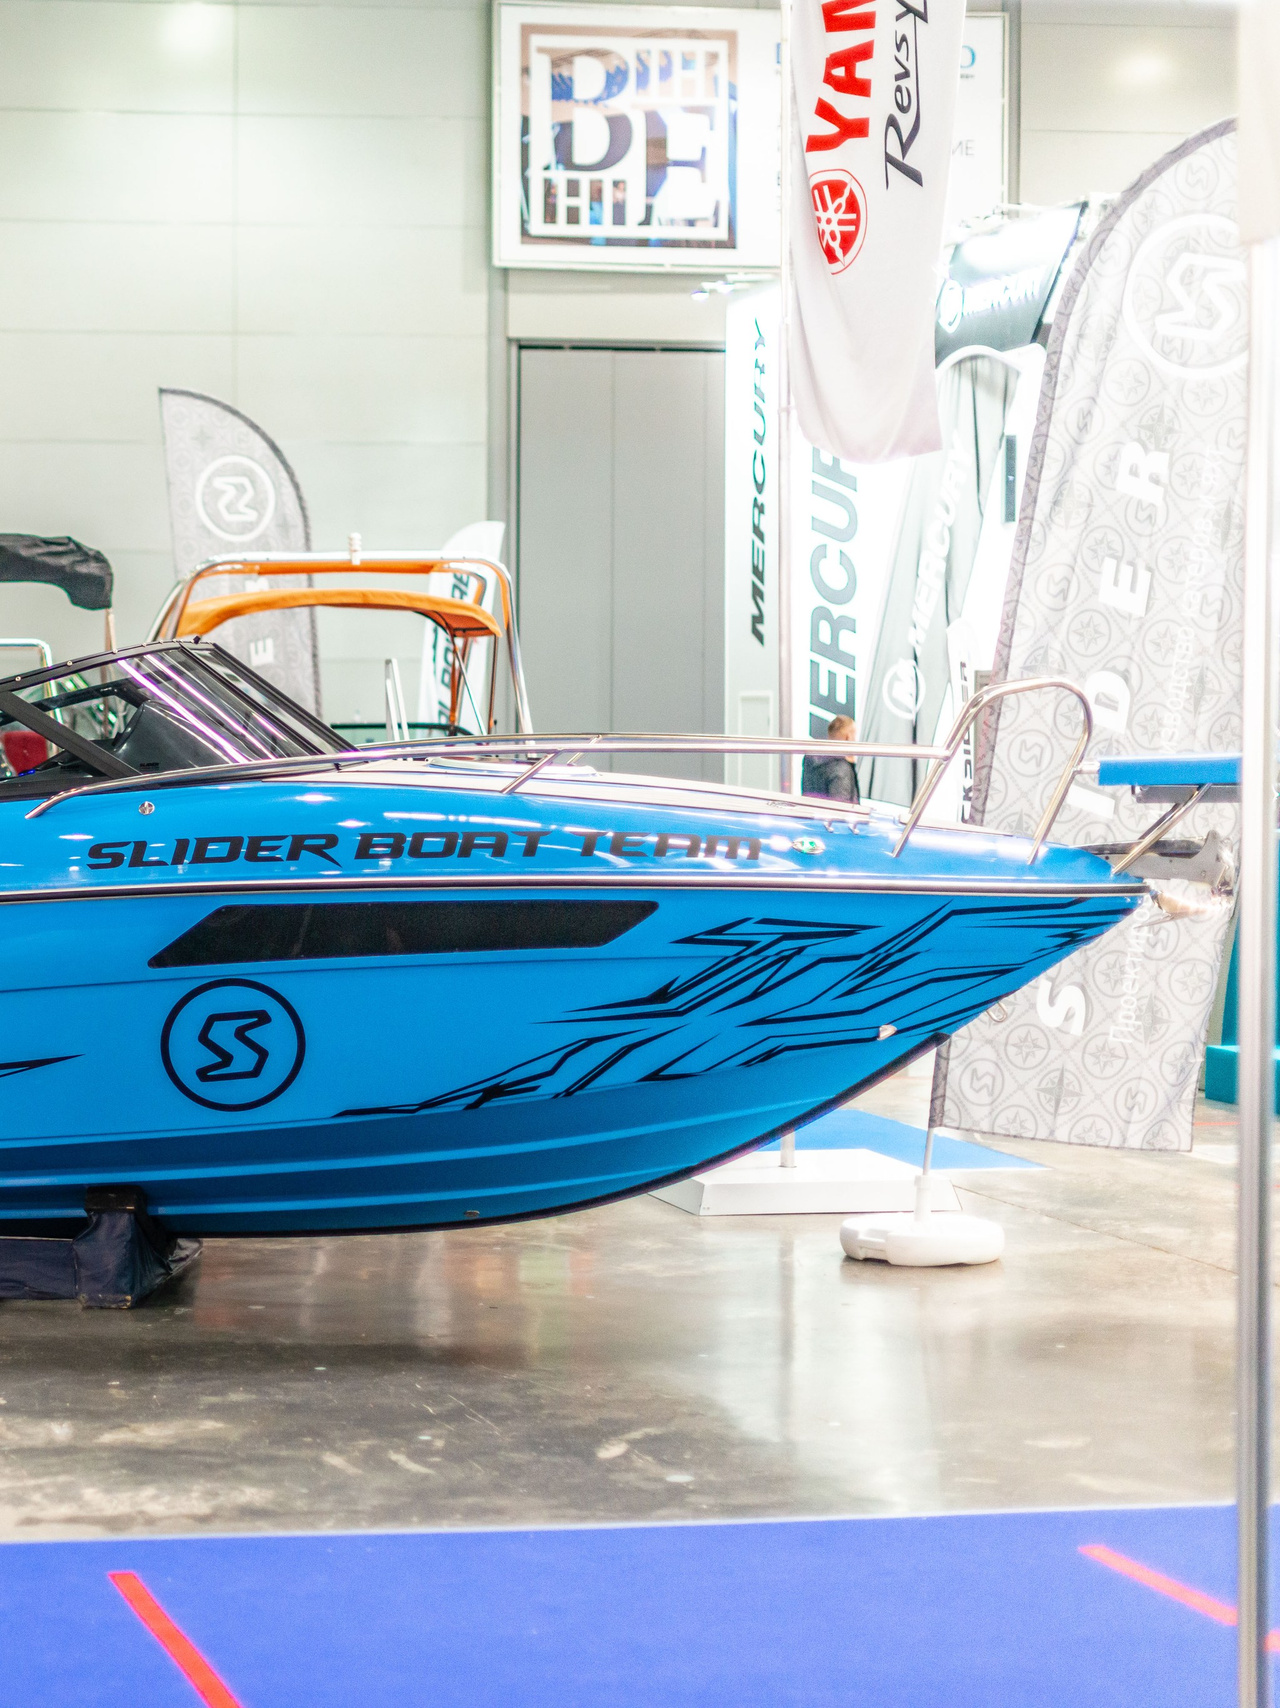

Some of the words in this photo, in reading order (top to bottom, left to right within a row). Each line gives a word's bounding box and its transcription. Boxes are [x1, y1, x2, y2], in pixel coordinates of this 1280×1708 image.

[884, 29, 924, 190] Revs
[751, 317, 767, 647] MERCURY
[907, 438, 973, 652] MERCURY
[1180, 518, 1214, 618] катеров
[87, 833, 342, 868] SLIDER
[354, 830, 556, 860] BOAT
[570, 830, 762, 861] TEAM
